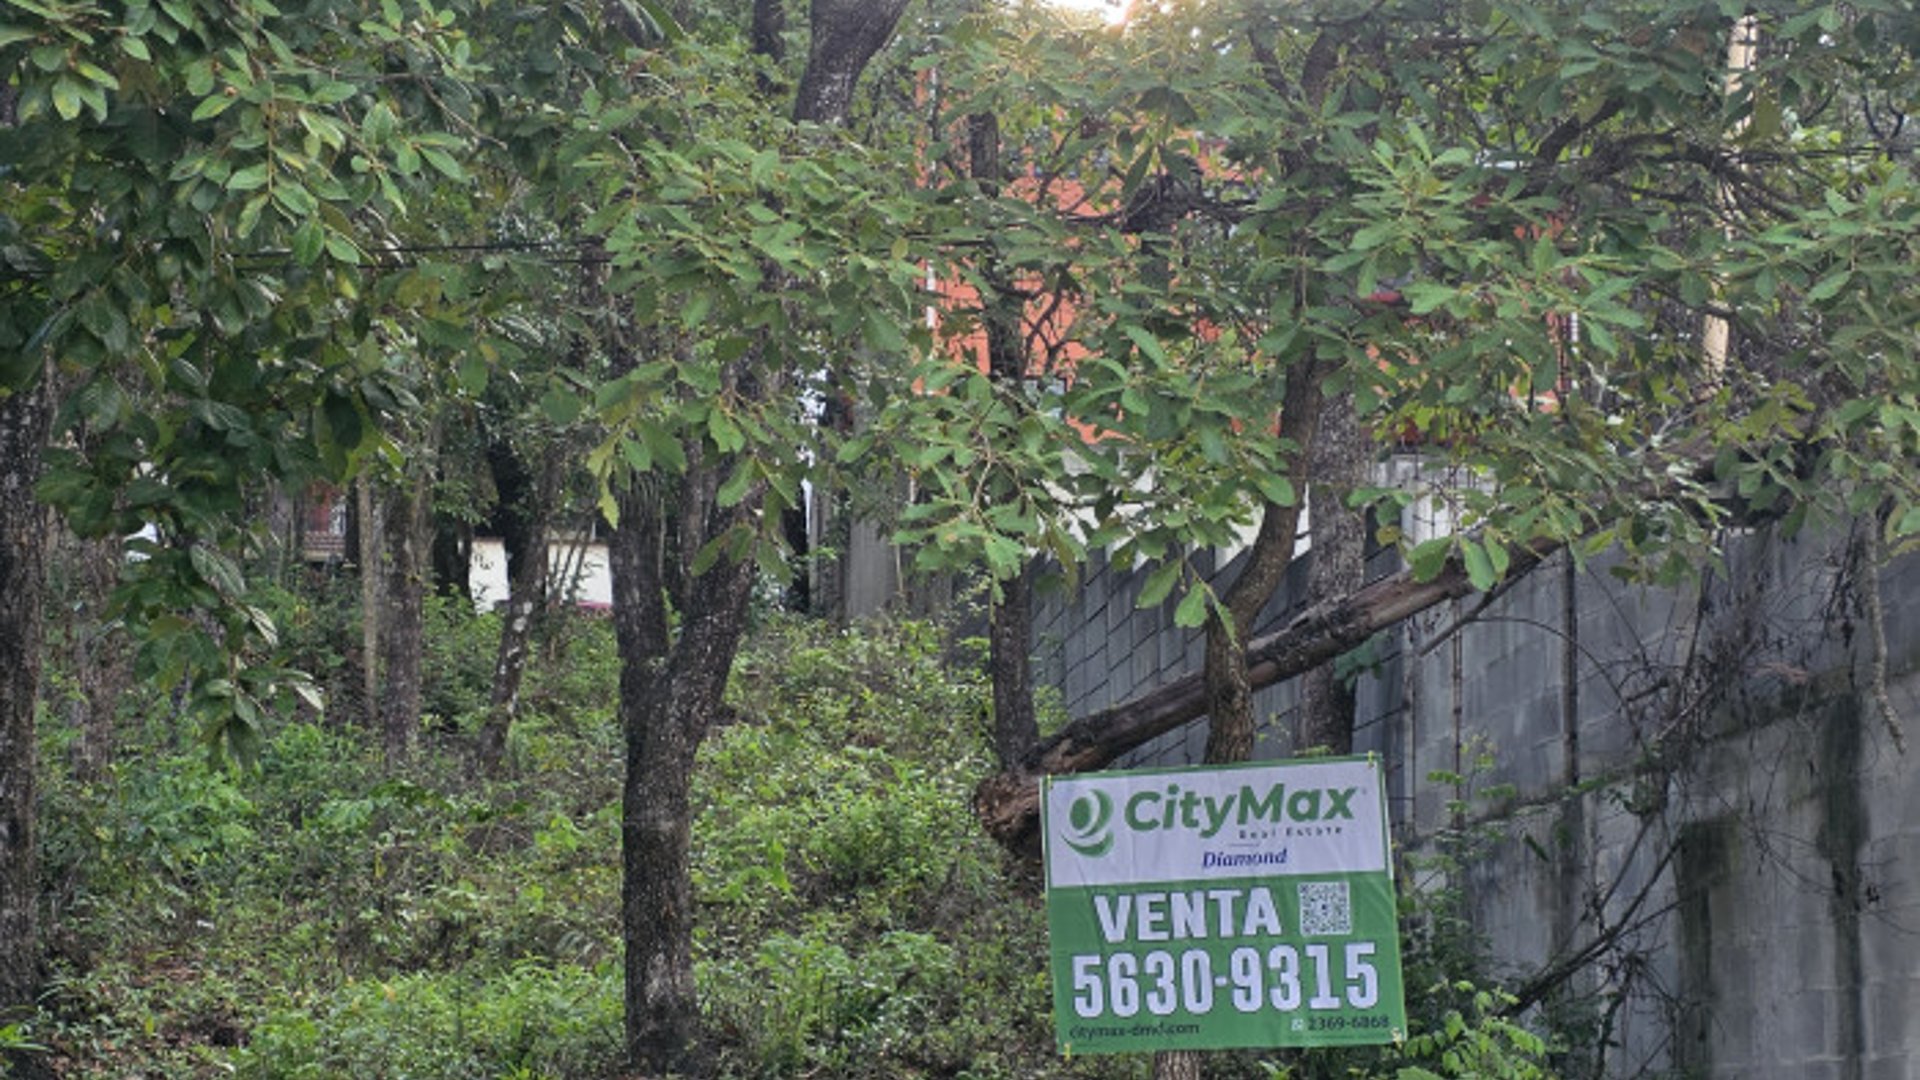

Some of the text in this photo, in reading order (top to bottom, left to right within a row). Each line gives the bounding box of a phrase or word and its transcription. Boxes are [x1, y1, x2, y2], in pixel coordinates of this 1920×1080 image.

[1124, 783, 1358, 839] CityMax
[1238, 826, 1343, 839] Real Estate
[1202, 848, 1287, 869] Diamond
[1094, 887, 1282, 943] VENTA
[1072, 942, 1379, 1018] 5630-9315
